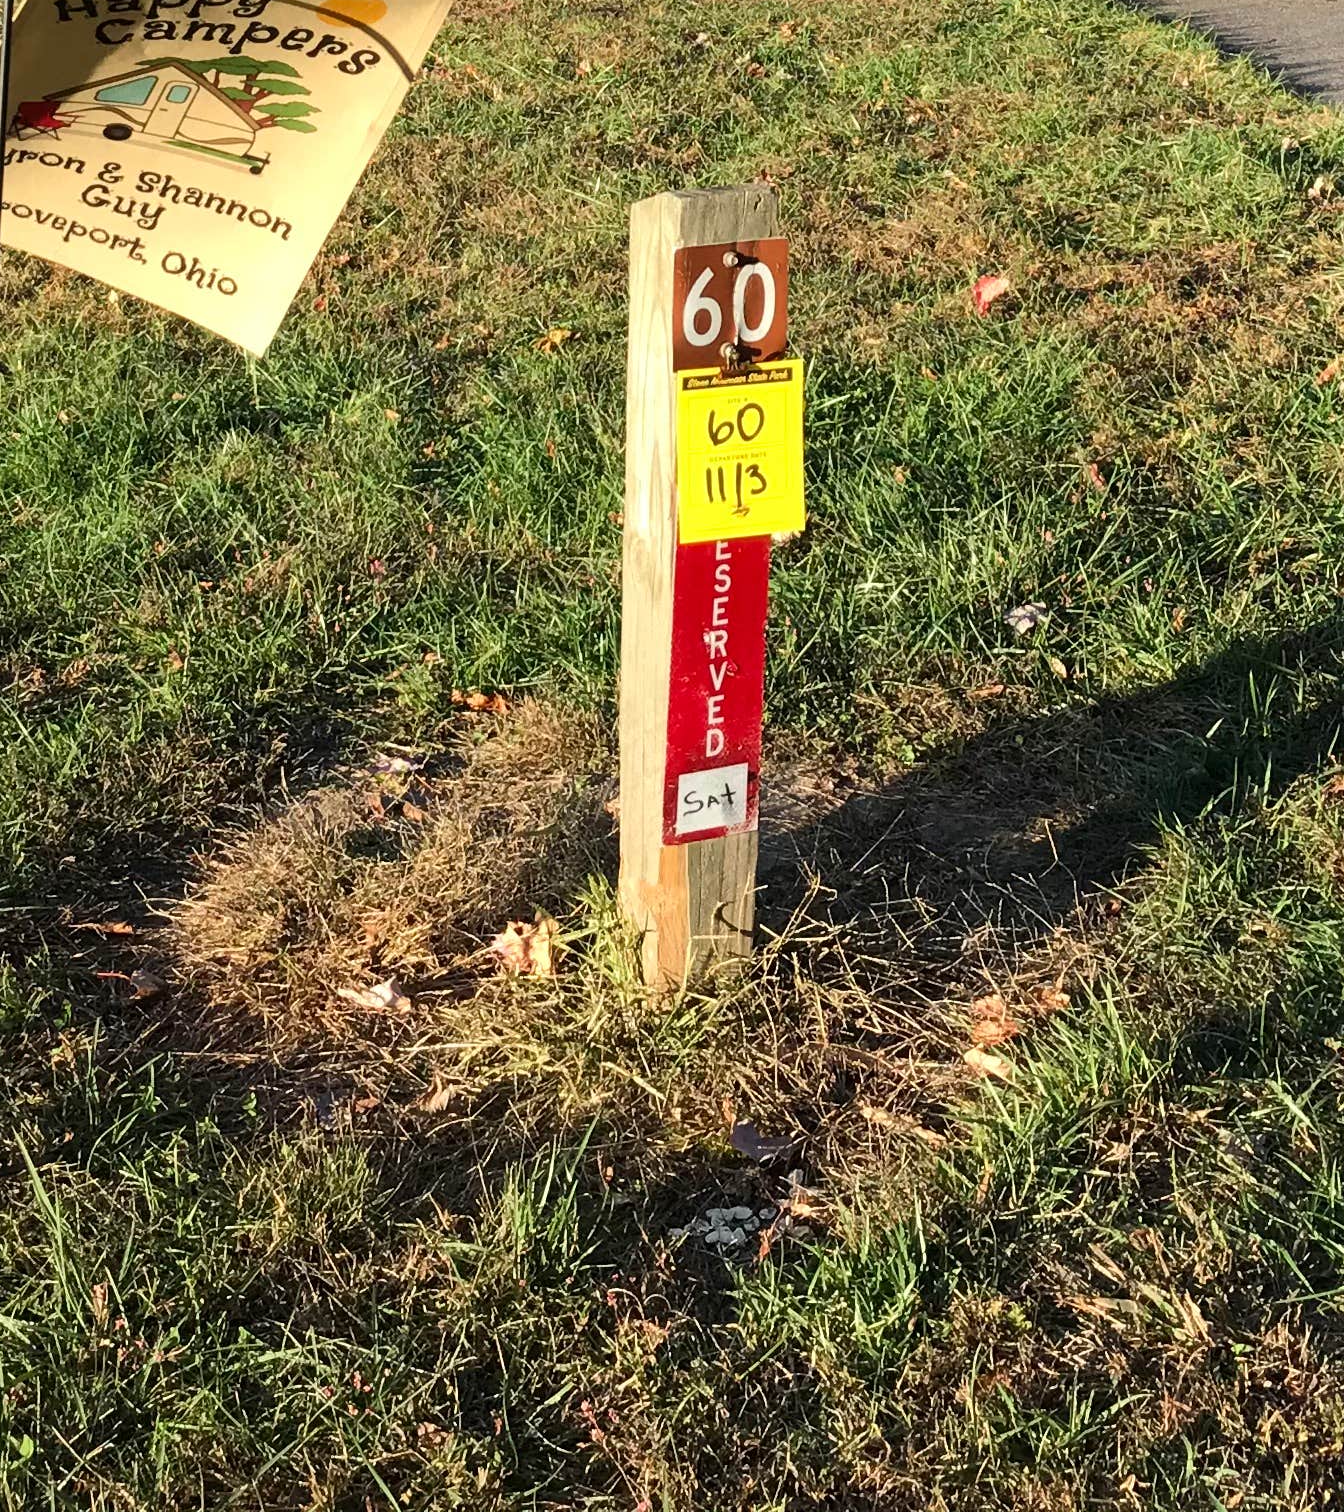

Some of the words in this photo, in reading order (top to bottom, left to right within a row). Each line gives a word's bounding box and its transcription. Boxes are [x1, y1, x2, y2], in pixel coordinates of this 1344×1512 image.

[94, 17, 381, 75] Campers
[81, 183, 167, 231] Guy
[97, 161, 124, 184] &
[135, 170, 294, 241] Shannon
[160, 252, 239, 296] Ohio
[683, 261, 776, 347] 60
[708, 403, 764, 446] 60
[705, 541, 731, 758] ESERVED
